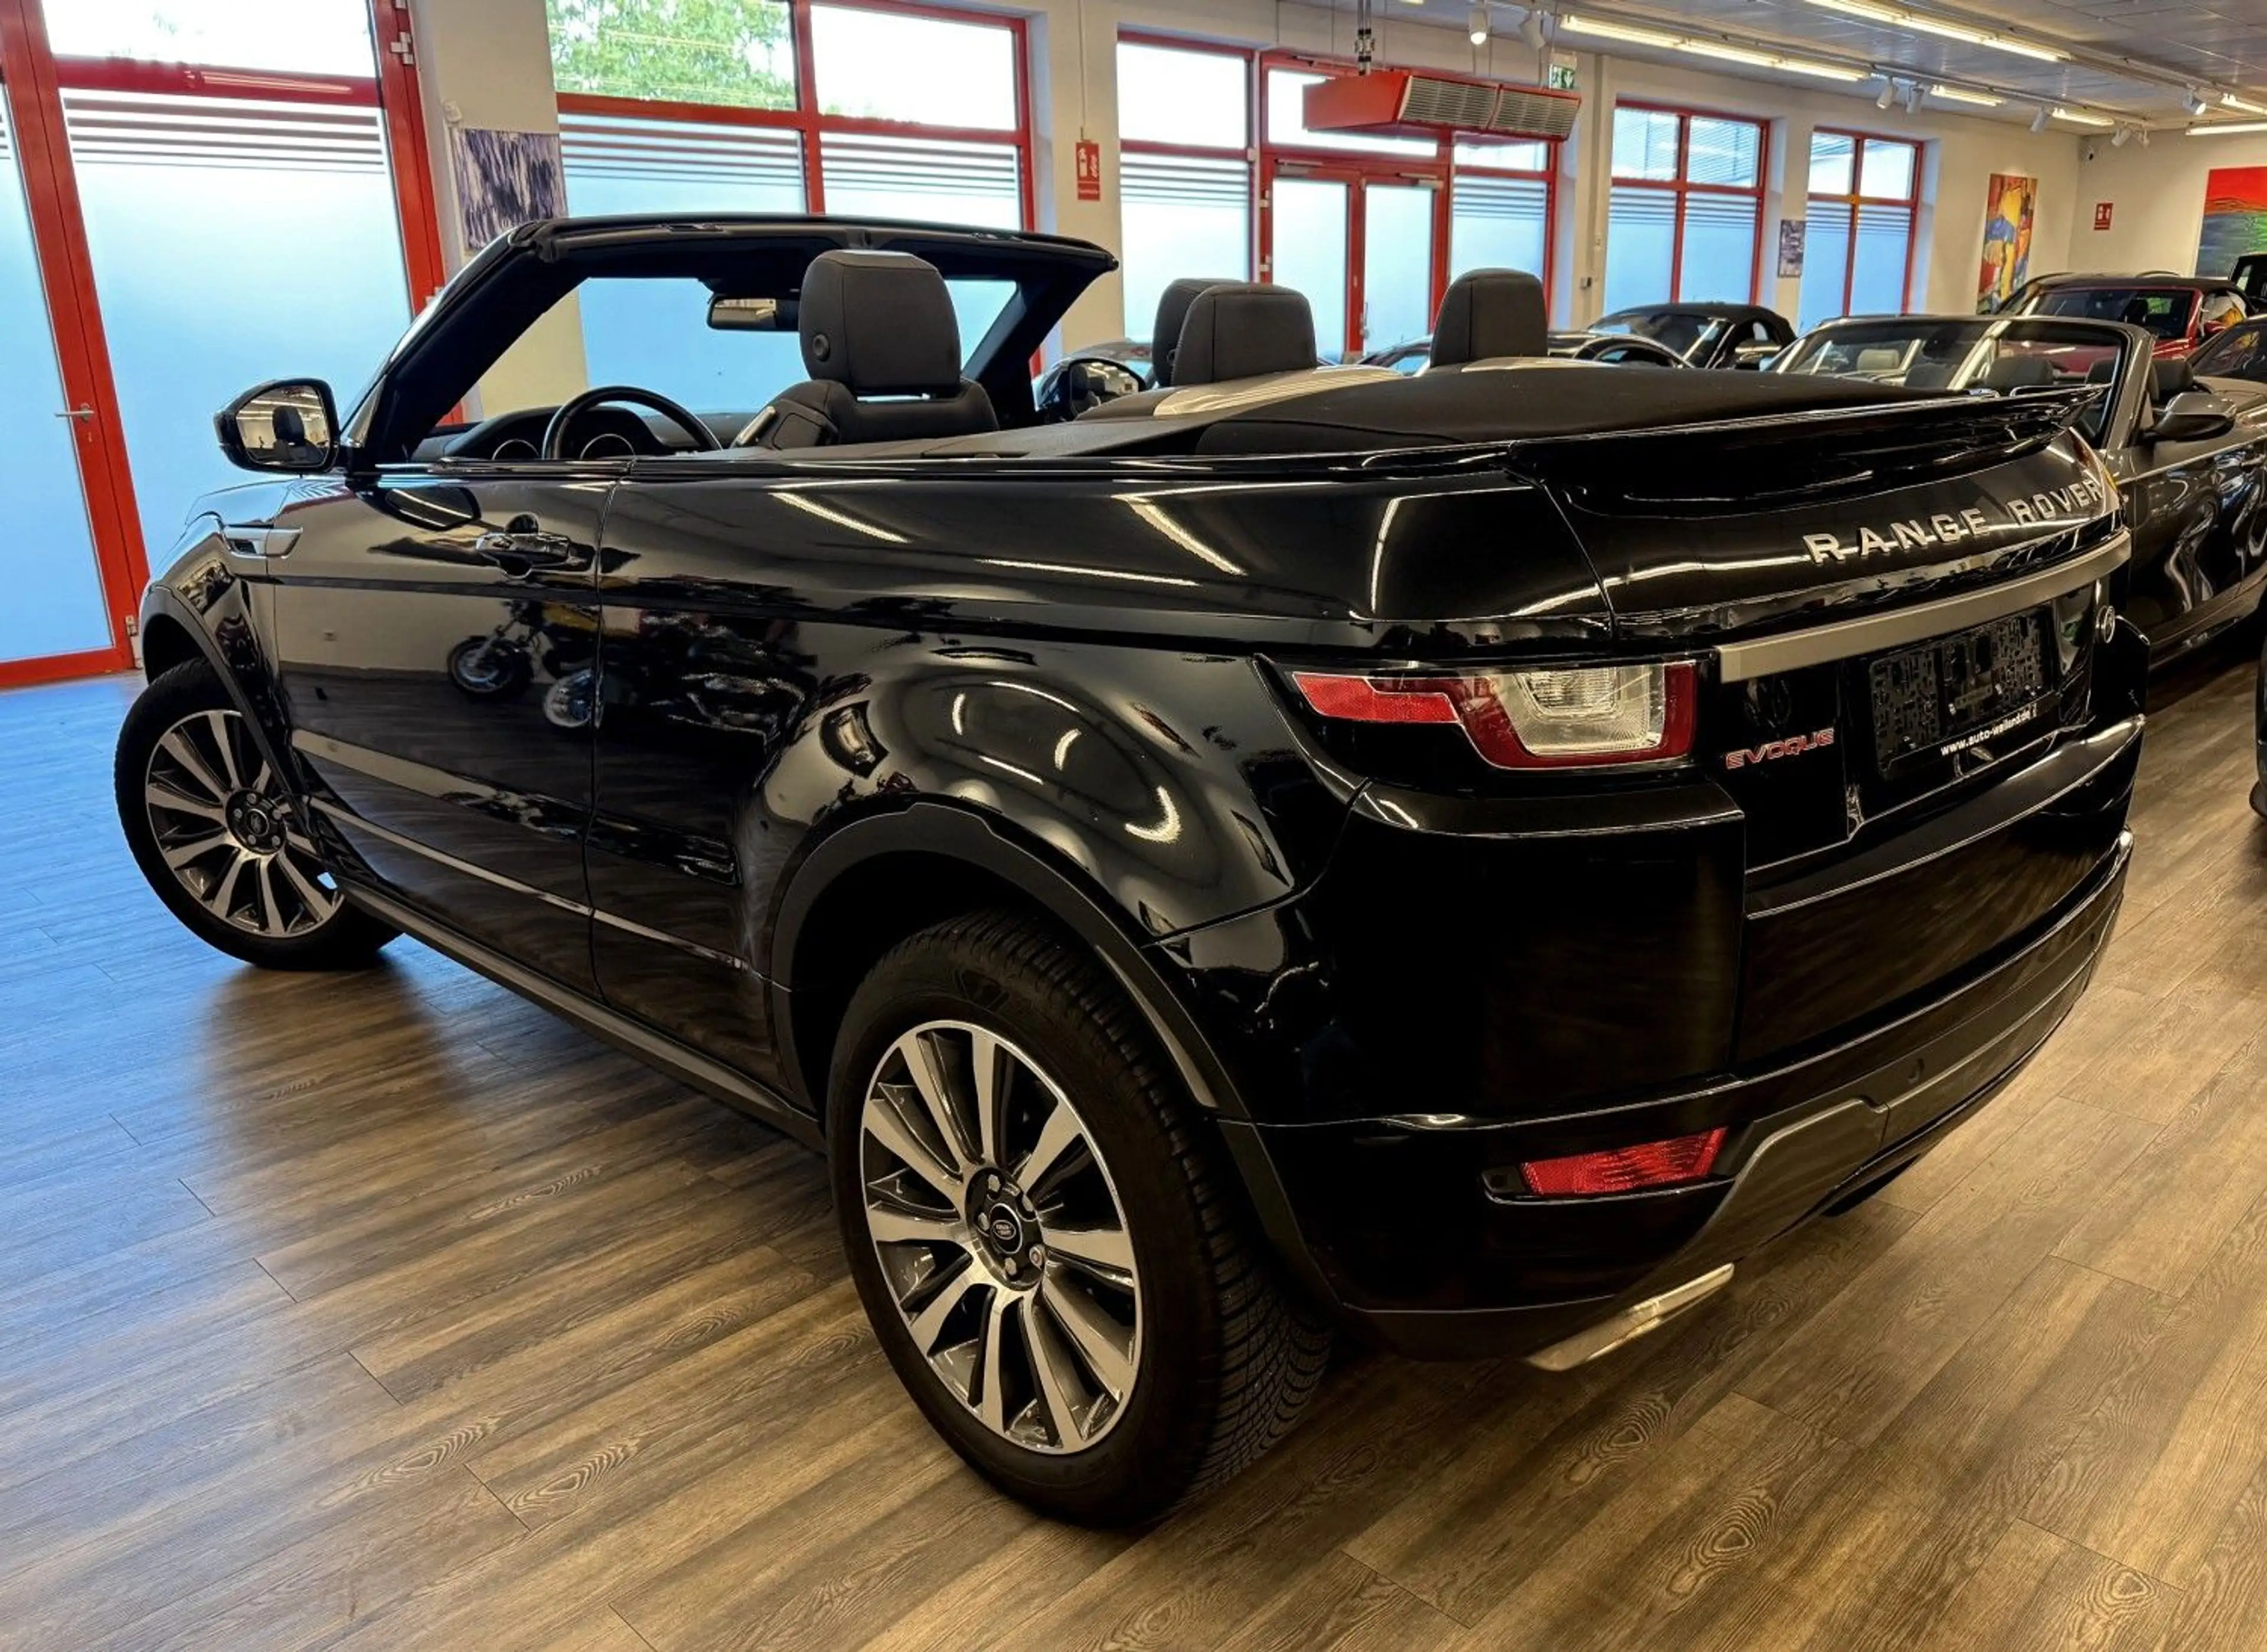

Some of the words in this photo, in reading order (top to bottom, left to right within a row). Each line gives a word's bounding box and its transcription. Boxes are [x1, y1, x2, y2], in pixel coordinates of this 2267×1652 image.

[1802, 508, 1990, 564] RANGE
[2006, 479, 2103, 525] ROVER
[1726, 727, 1834, 770] EVOQUE
